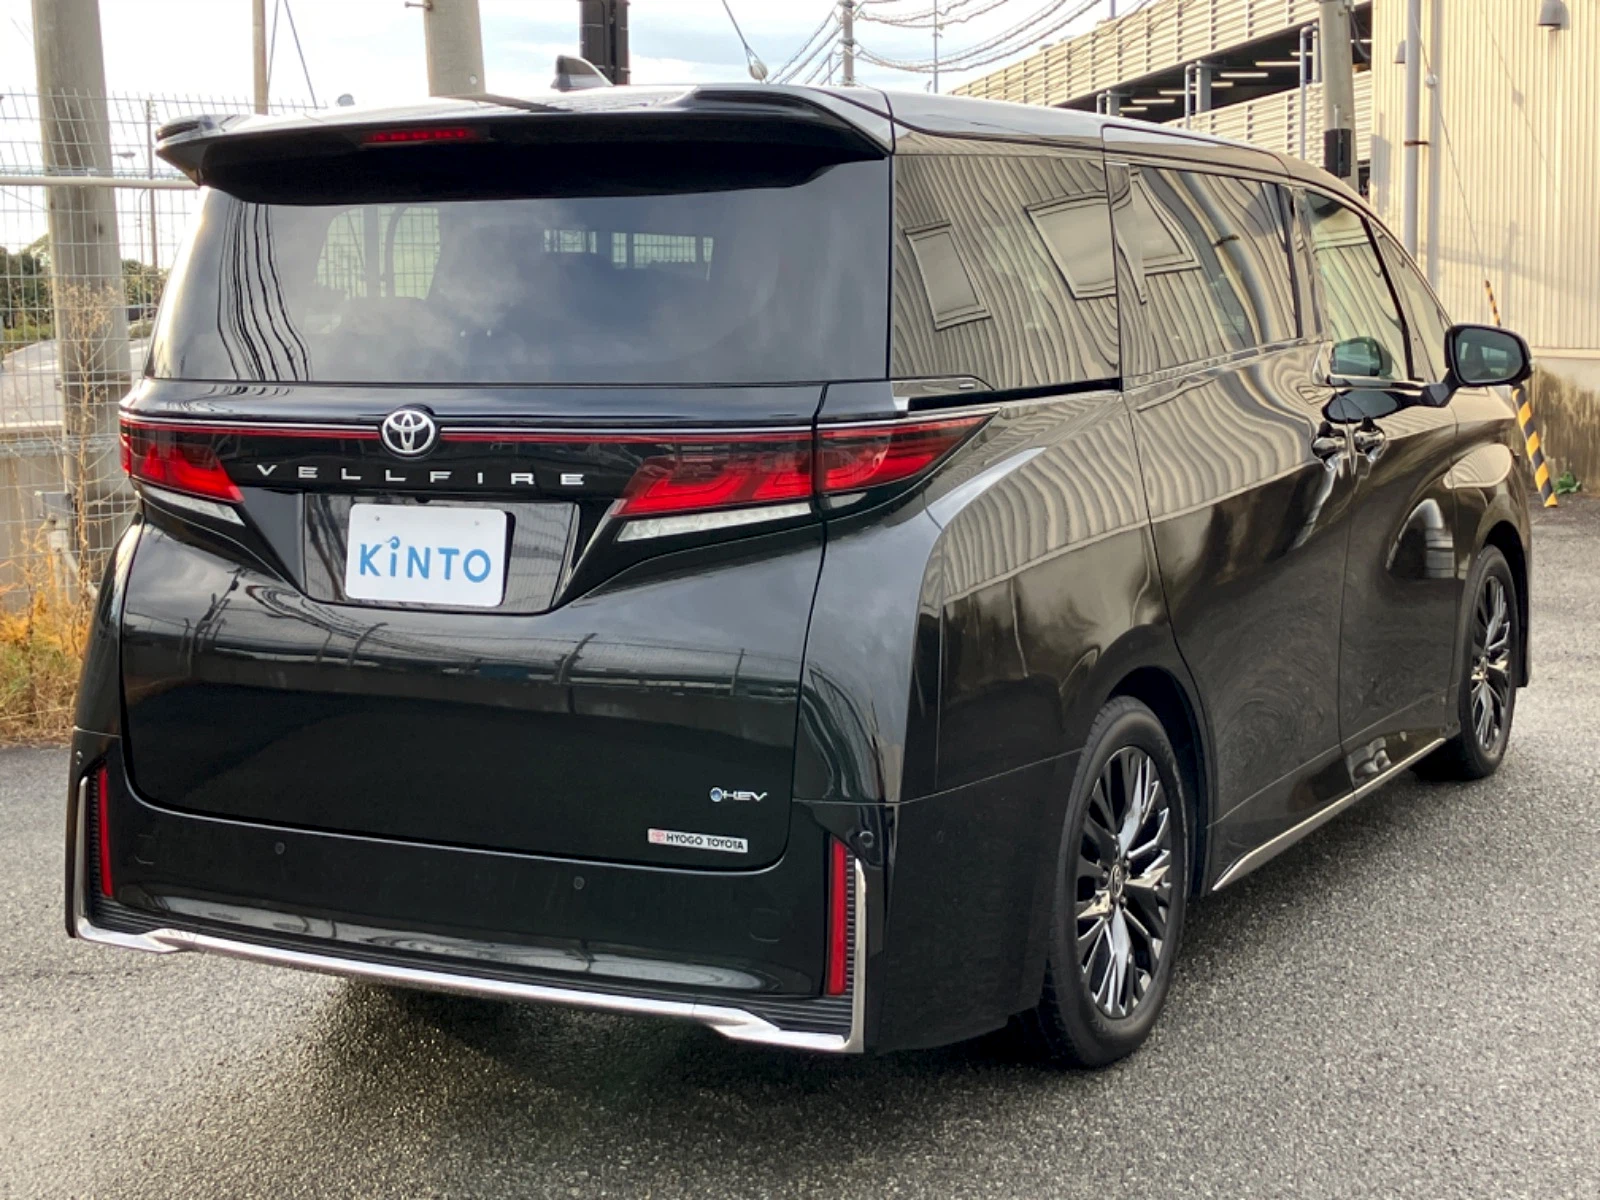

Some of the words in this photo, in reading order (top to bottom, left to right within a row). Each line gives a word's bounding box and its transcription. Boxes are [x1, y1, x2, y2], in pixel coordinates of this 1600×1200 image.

[257, 464, 585, 485] VELLFIRE
[666, 833, 703, 845] HYOGO
[707, 838, 744, 849] TOYOTA
